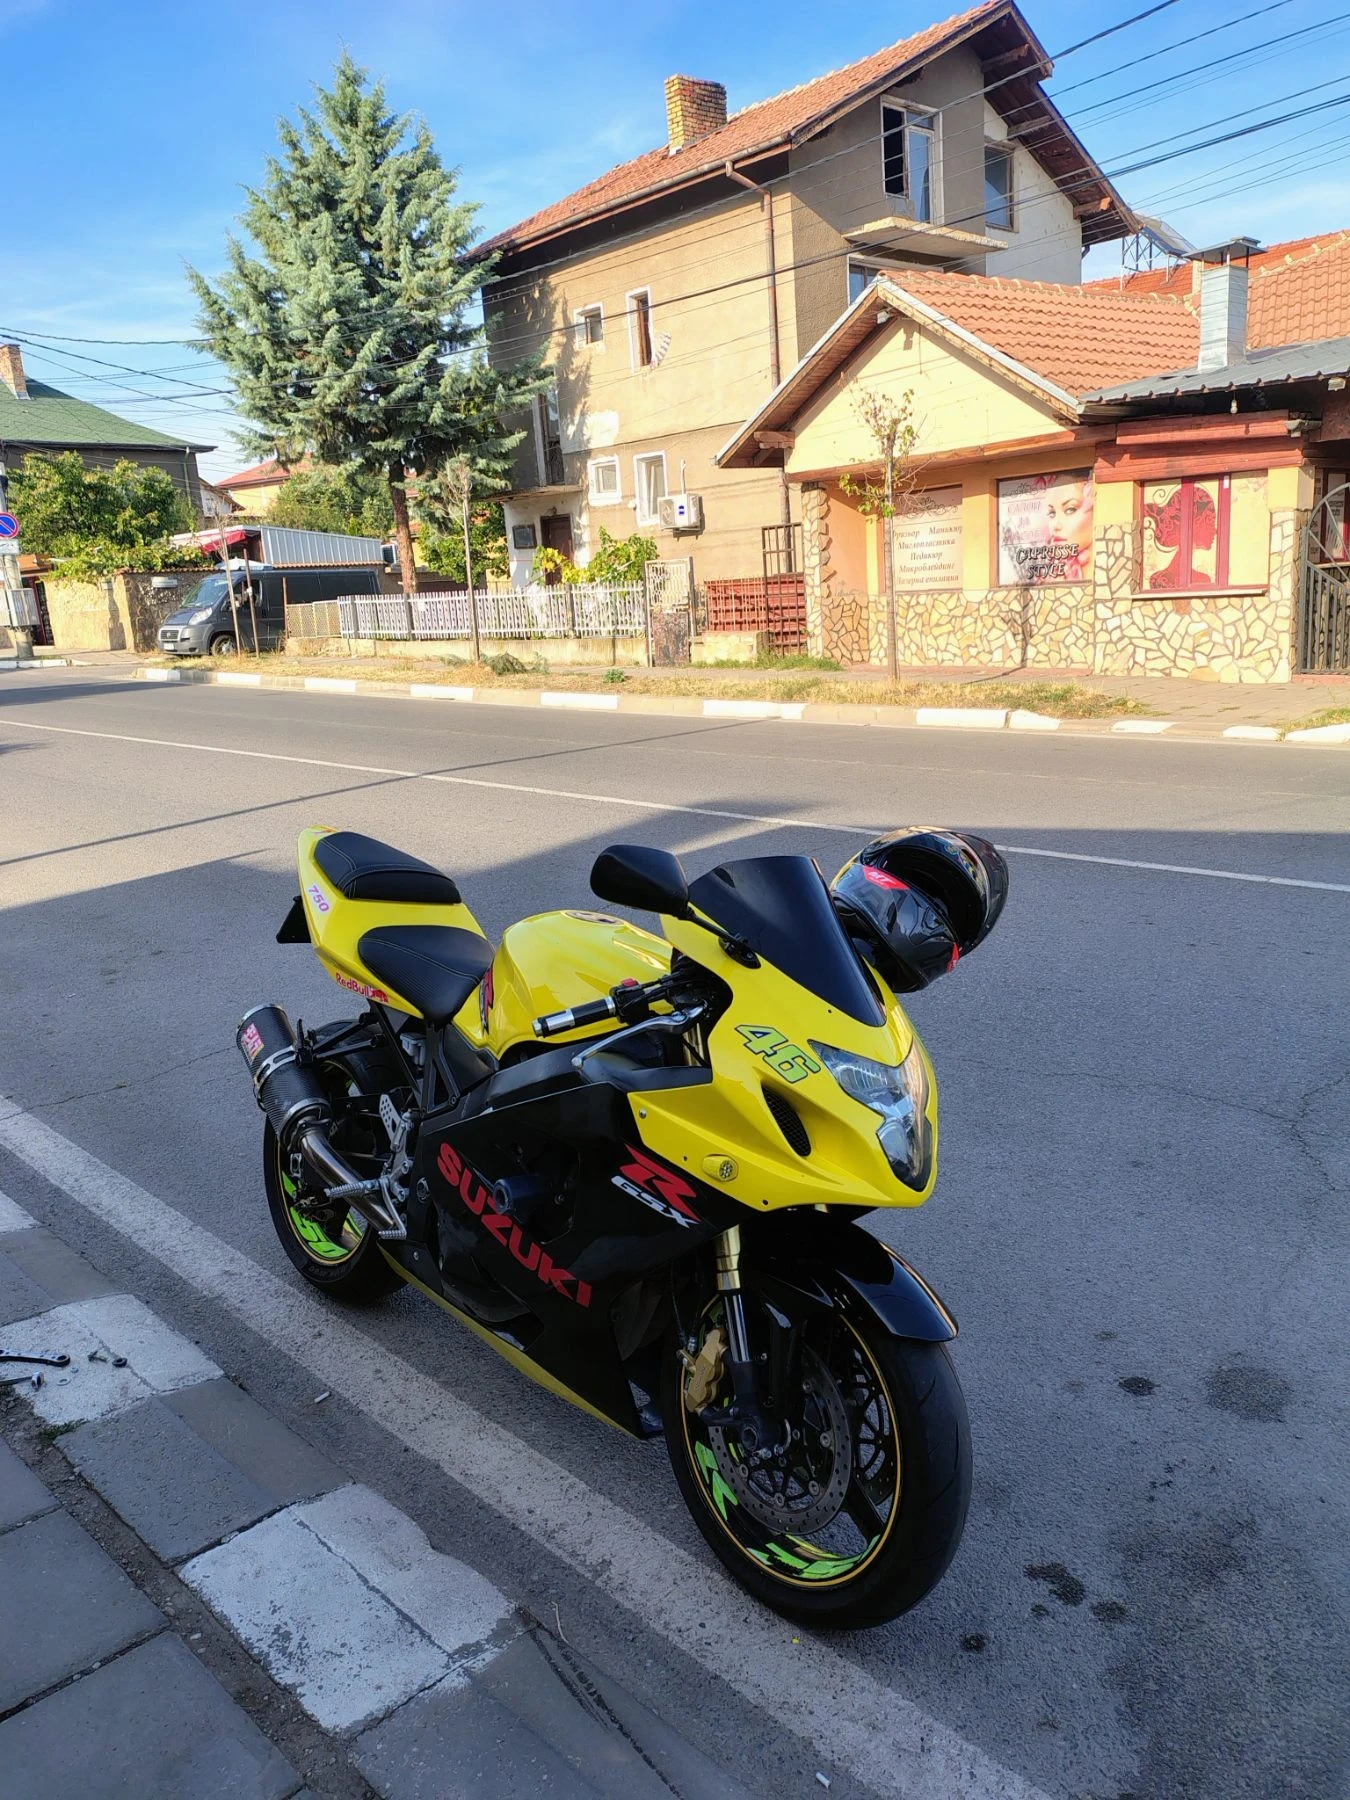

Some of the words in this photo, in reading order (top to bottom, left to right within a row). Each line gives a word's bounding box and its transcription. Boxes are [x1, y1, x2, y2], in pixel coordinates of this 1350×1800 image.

[1016, 543, 1079, 565] CAPRISSE
[308, 884, 330, 911] 750
[733, 1024, 821, 1084] 46
[437, 1142, 592, 1309] SUZUKI
